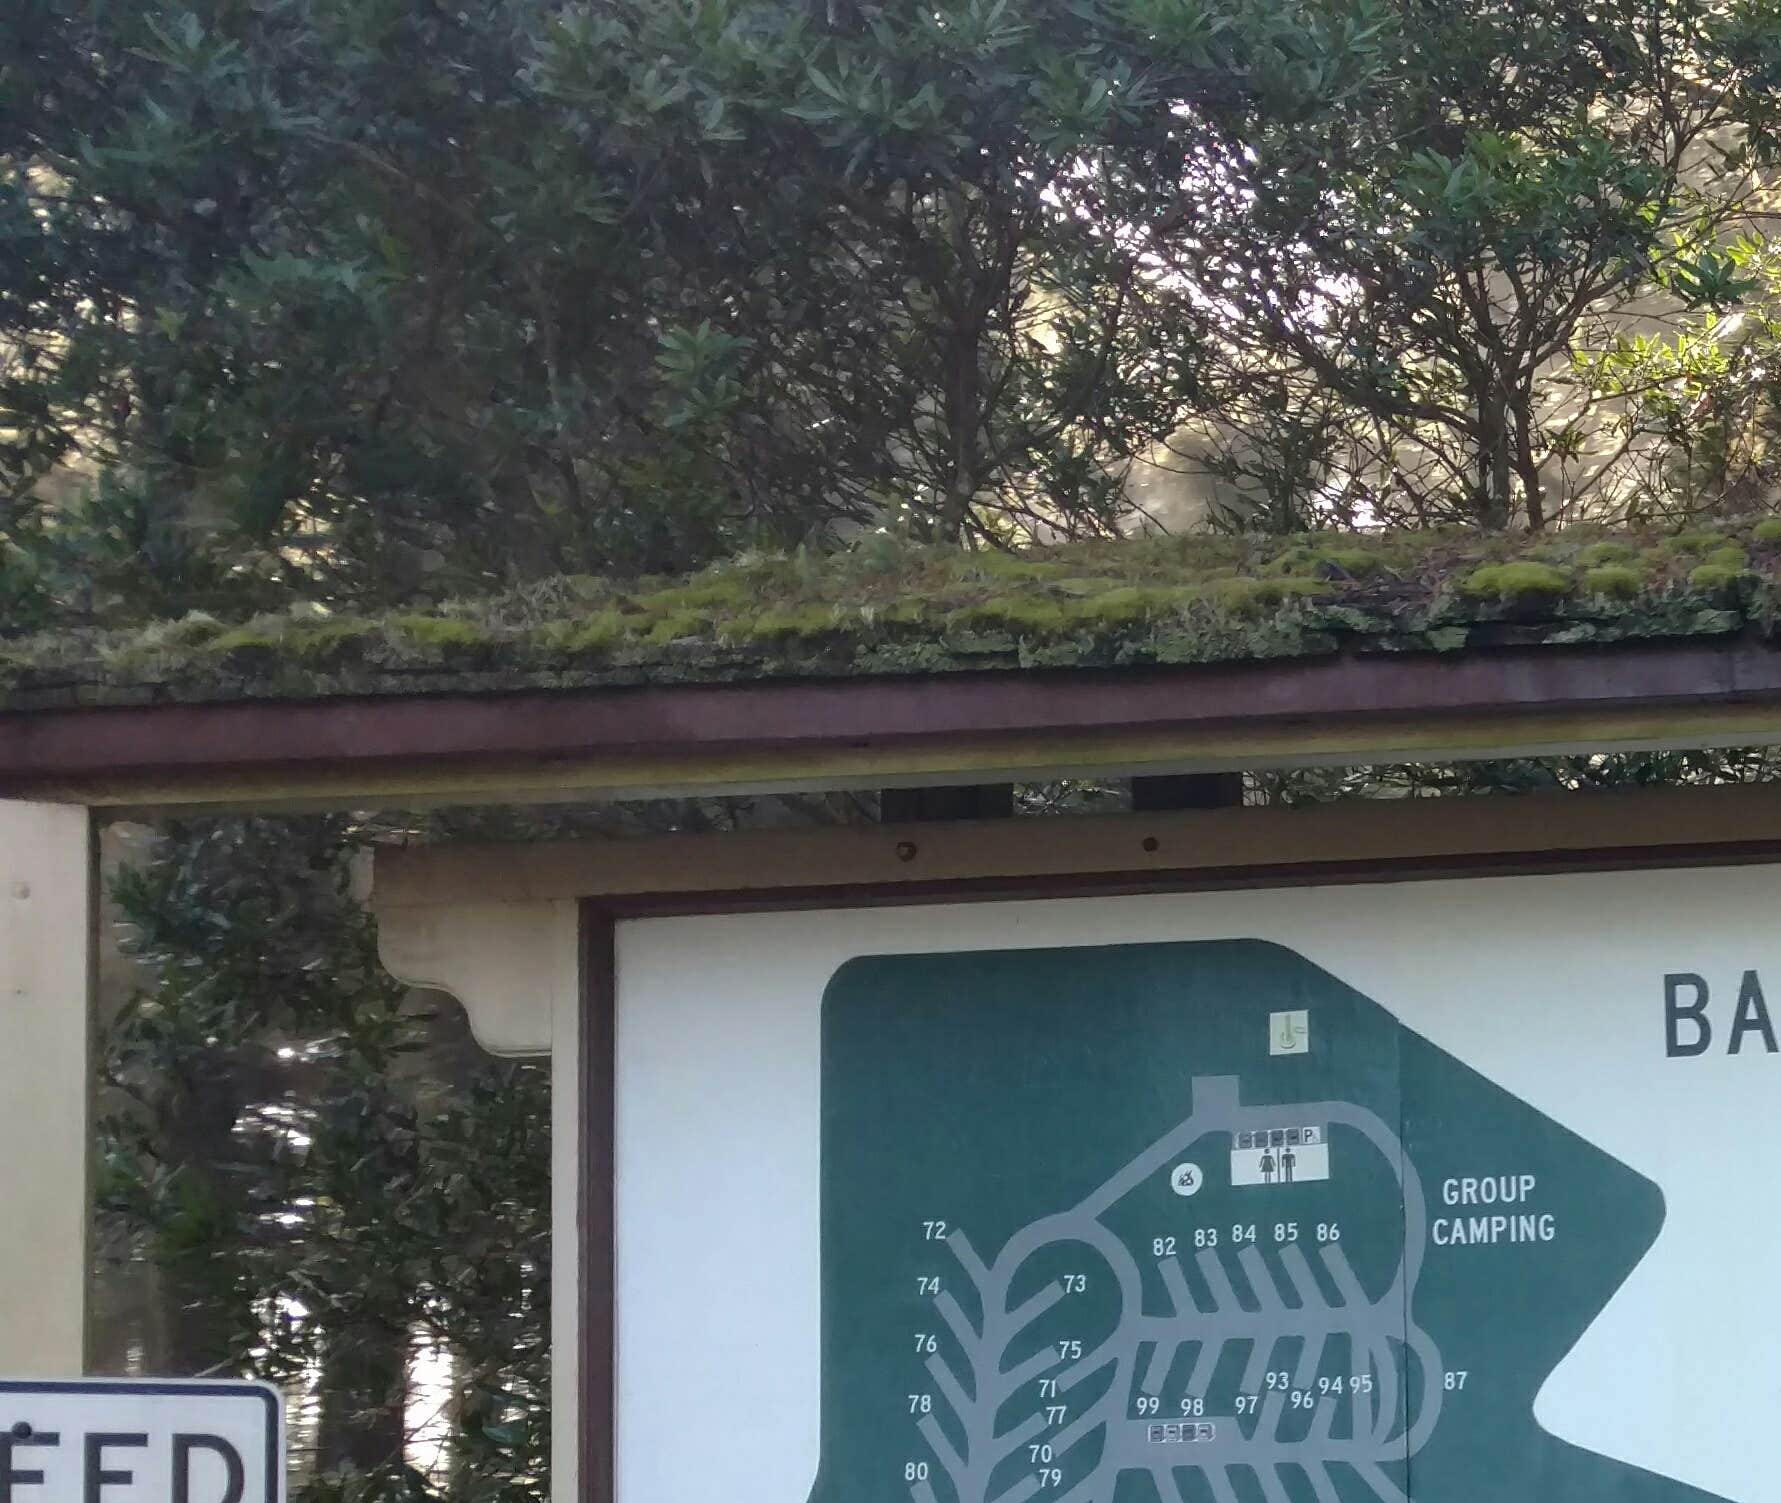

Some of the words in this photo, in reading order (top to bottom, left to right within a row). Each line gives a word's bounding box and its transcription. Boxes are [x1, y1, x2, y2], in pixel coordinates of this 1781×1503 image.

[1443, 1174, 1536, 1205] GROUP
[923, 1221, 946, 1240] 72
[1194, 1228, 1218, 1247] 83
[1232, 1224, 1257, 1243] 84
[1274, 1222, 1298, 1242] 85
[1316, 1223, 1340, 1242] 86
[1432, 1214, 1555, 1245] CAMPING
[1153, 1236, 1177, 1257] 82
[917, 1276, 940, 1296] 74
[1063, 1274, 1086, 1294] 73
[914, 1334, 937, 1353] 76
[1059, 1340, 1082, 1360] 75
[1039, 1379, 1057, 1398] 71
[1265, 1371, 1289, 1390] 93
[1318, 1375, 1343, 1395] 94
[1349, 1373, 1373, 1395] 95
[1444, 1371, 1468, 1390] 87
[908, 1394, 931, 1414] 78
[1136, 1396, 1160, 1416] 99
[1180, 1398, 1204, 1417] 98
[1235, 1395, 1259, 1415] 97
[1291, 1390, 1314, 1409] 96
[1045, 1405, 1067, 1425] 77
[1028, 1444, 1052, 1463] 70
[904, 1462, 929, 1481] 80
[1039, 1468, 1062, 1488] 79
